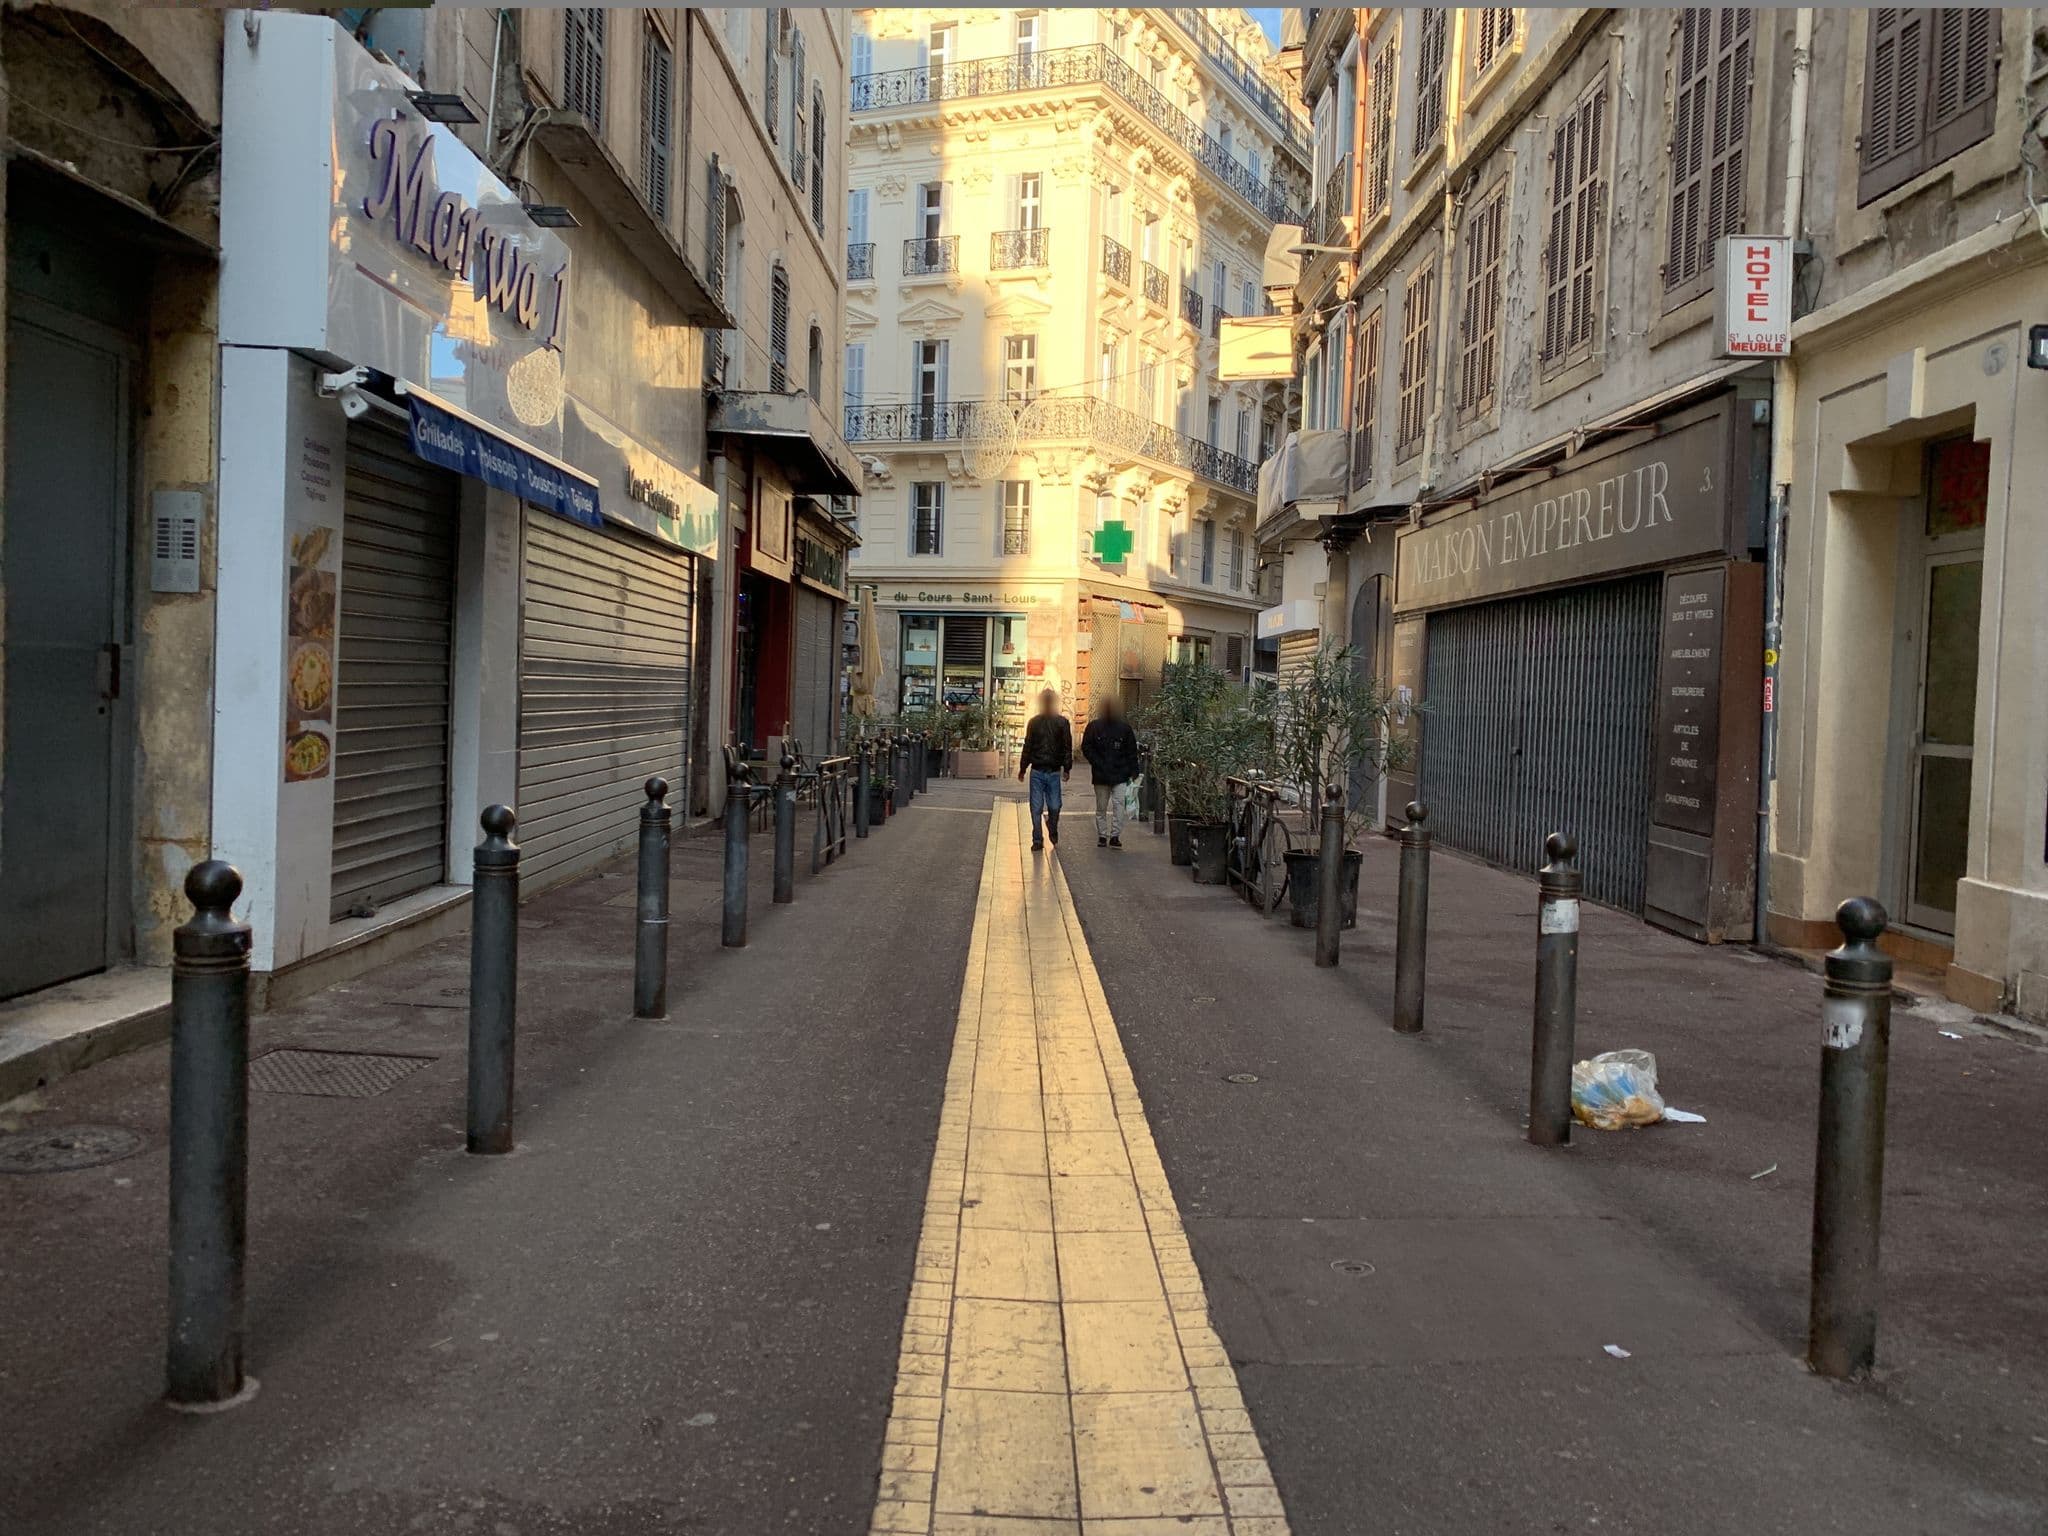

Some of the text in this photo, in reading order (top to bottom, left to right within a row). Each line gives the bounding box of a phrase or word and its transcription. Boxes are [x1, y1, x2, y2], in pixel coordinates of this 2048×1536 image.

[363, 118, 540, 330] Marwa
[1746, 246, 1770, 322] HOTEL
[1747, 333, 1787, 343] LOUIS
[1731, 342, 1783, 352] MEUBLE
[417, 417, 464, 456] Grillades
[571, 487, 593, 513] Tajines
[1412, 519, 1495, 586] MAISON
[1500, 461, 1673, 565] EMPEREUR
[894, 592, 908, 602] du
[919, 592, 952, 603] Cours
[963, 592, 993, 603] Saint
[1004, 593, 1036, 604] Louis
[1686, 611, 1693, 620] ET
[1671, 648, 1710, 658] AMEUBLEMENT
[1673, 724, 1699, 735] ARTICLES
[1681, 741, 1689, 751] DE
